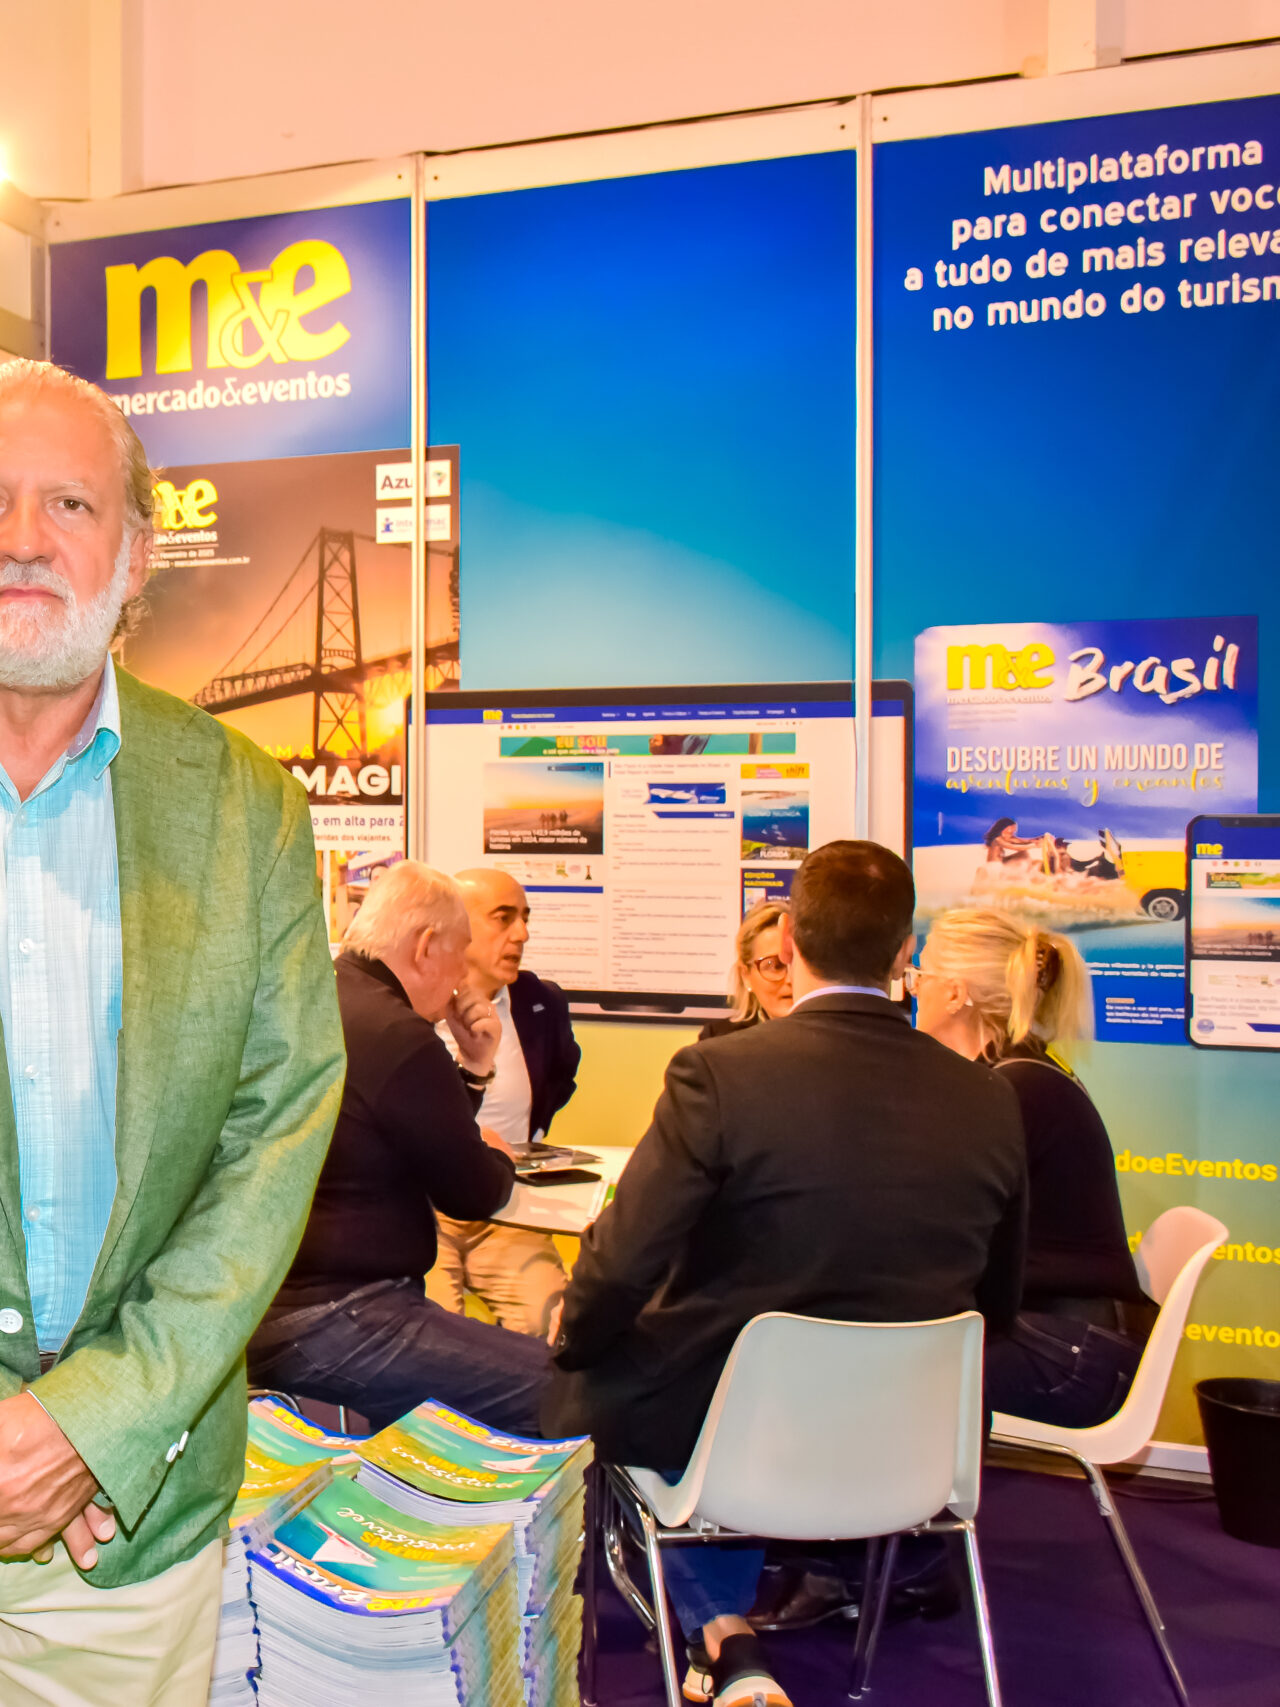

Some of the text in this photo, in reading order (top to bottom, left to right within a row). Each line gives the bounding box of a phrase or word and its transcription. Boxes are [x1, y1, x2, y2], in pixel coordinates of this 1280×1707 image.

[984, 140, 1263, 196] Multiplataforma
[952, 184, 1280, 250] para conectar voc
[904, 267, 923, 291] a
[935, 255, 1012, 288] tudo
[1025, 248, 1069, 278] de
[1082, 237, 1166, 273] mais
[105, 239, 352, 380] m&e
[933, 305, 974, 331] no
[987, 289, 1107, 326] mundo
[1120, 283, 1165, 314] do
[946, 634, 1240, 704] m&e Brasil
[946, 743, 1224, 772] DESCUBRE UN MUNDO DE
[323, 817, 341, 826] em
[344, 816, 366, 826] alta
[370, 817, 395, 829] para
[1115, 1149, 1278, 1181] doeEventos
